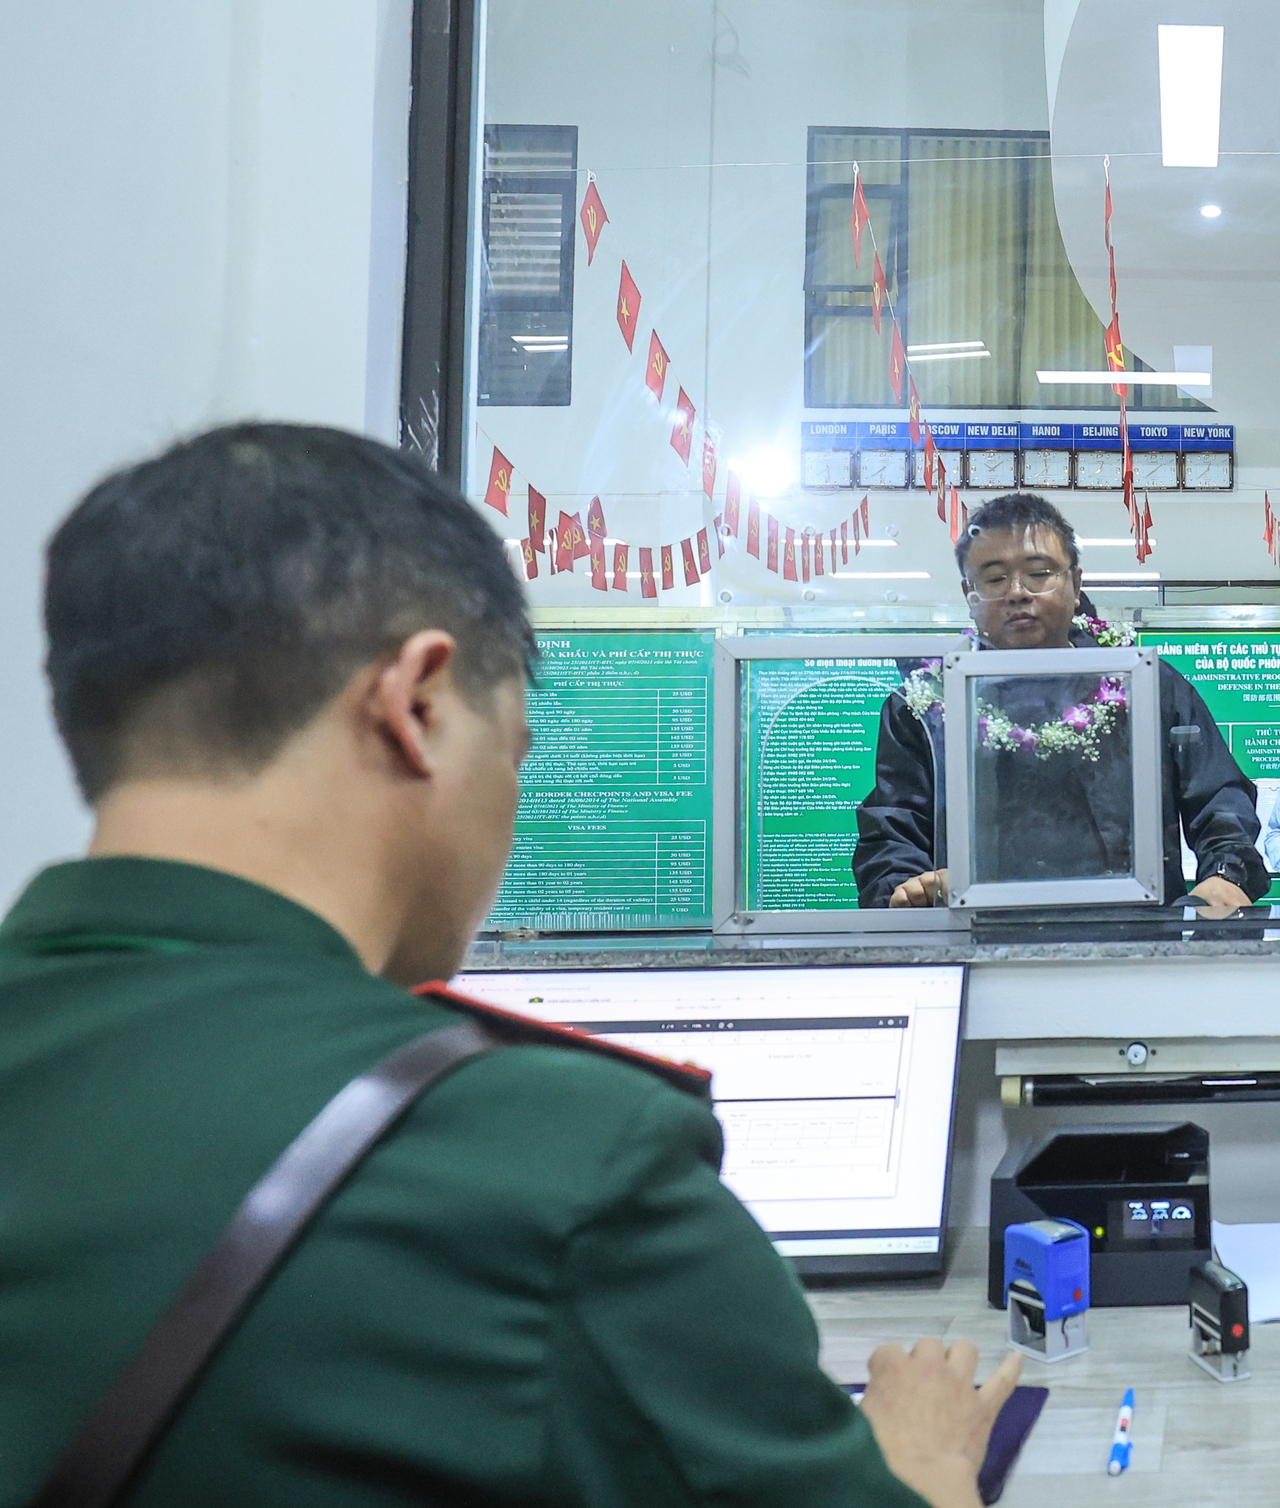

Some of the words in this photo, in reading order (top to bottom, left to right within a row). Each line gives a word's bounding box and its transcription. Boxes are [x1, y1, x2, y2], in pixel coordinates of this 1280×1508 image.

[809, 424, 847, 434] LONDON
[869, 424, 896, 434] PARIS
[967, 426, 988, 435] NEW
[992, 426, 1017, 435] DELHI
[1031, 425, 1060, 436] HANOI
[1082, 427, 1118, 436] BEIJING
[1140, 426, 1167, 437] TOKYO
[1183, 427, 1205, 437] NEW
[1207, 427, 1230, 437] YORK
[536, 640, 570, 649] ĐỊNH
[1157, 642, 1182, 654] BẢNG
[1184, 642, 1208, 654] NIÊM
[1210, 642, 1227, 654] YẾT
[1229, 642, 1248, 654] CÁC
[1250, 641, 1268, 654] THỦ
[541, 649, 555, 658] ỬA
[629, 649, 651, 657] CẤP
[1195, 656, 1214, 668] CỦA
[1216, 656, 1228, 670] BỘ
[1231, 656, 1256, 668] QUỐC
[1255, 728, 1272, 736] THỦ
[1244, 738, 1268, 746] HÀNH
